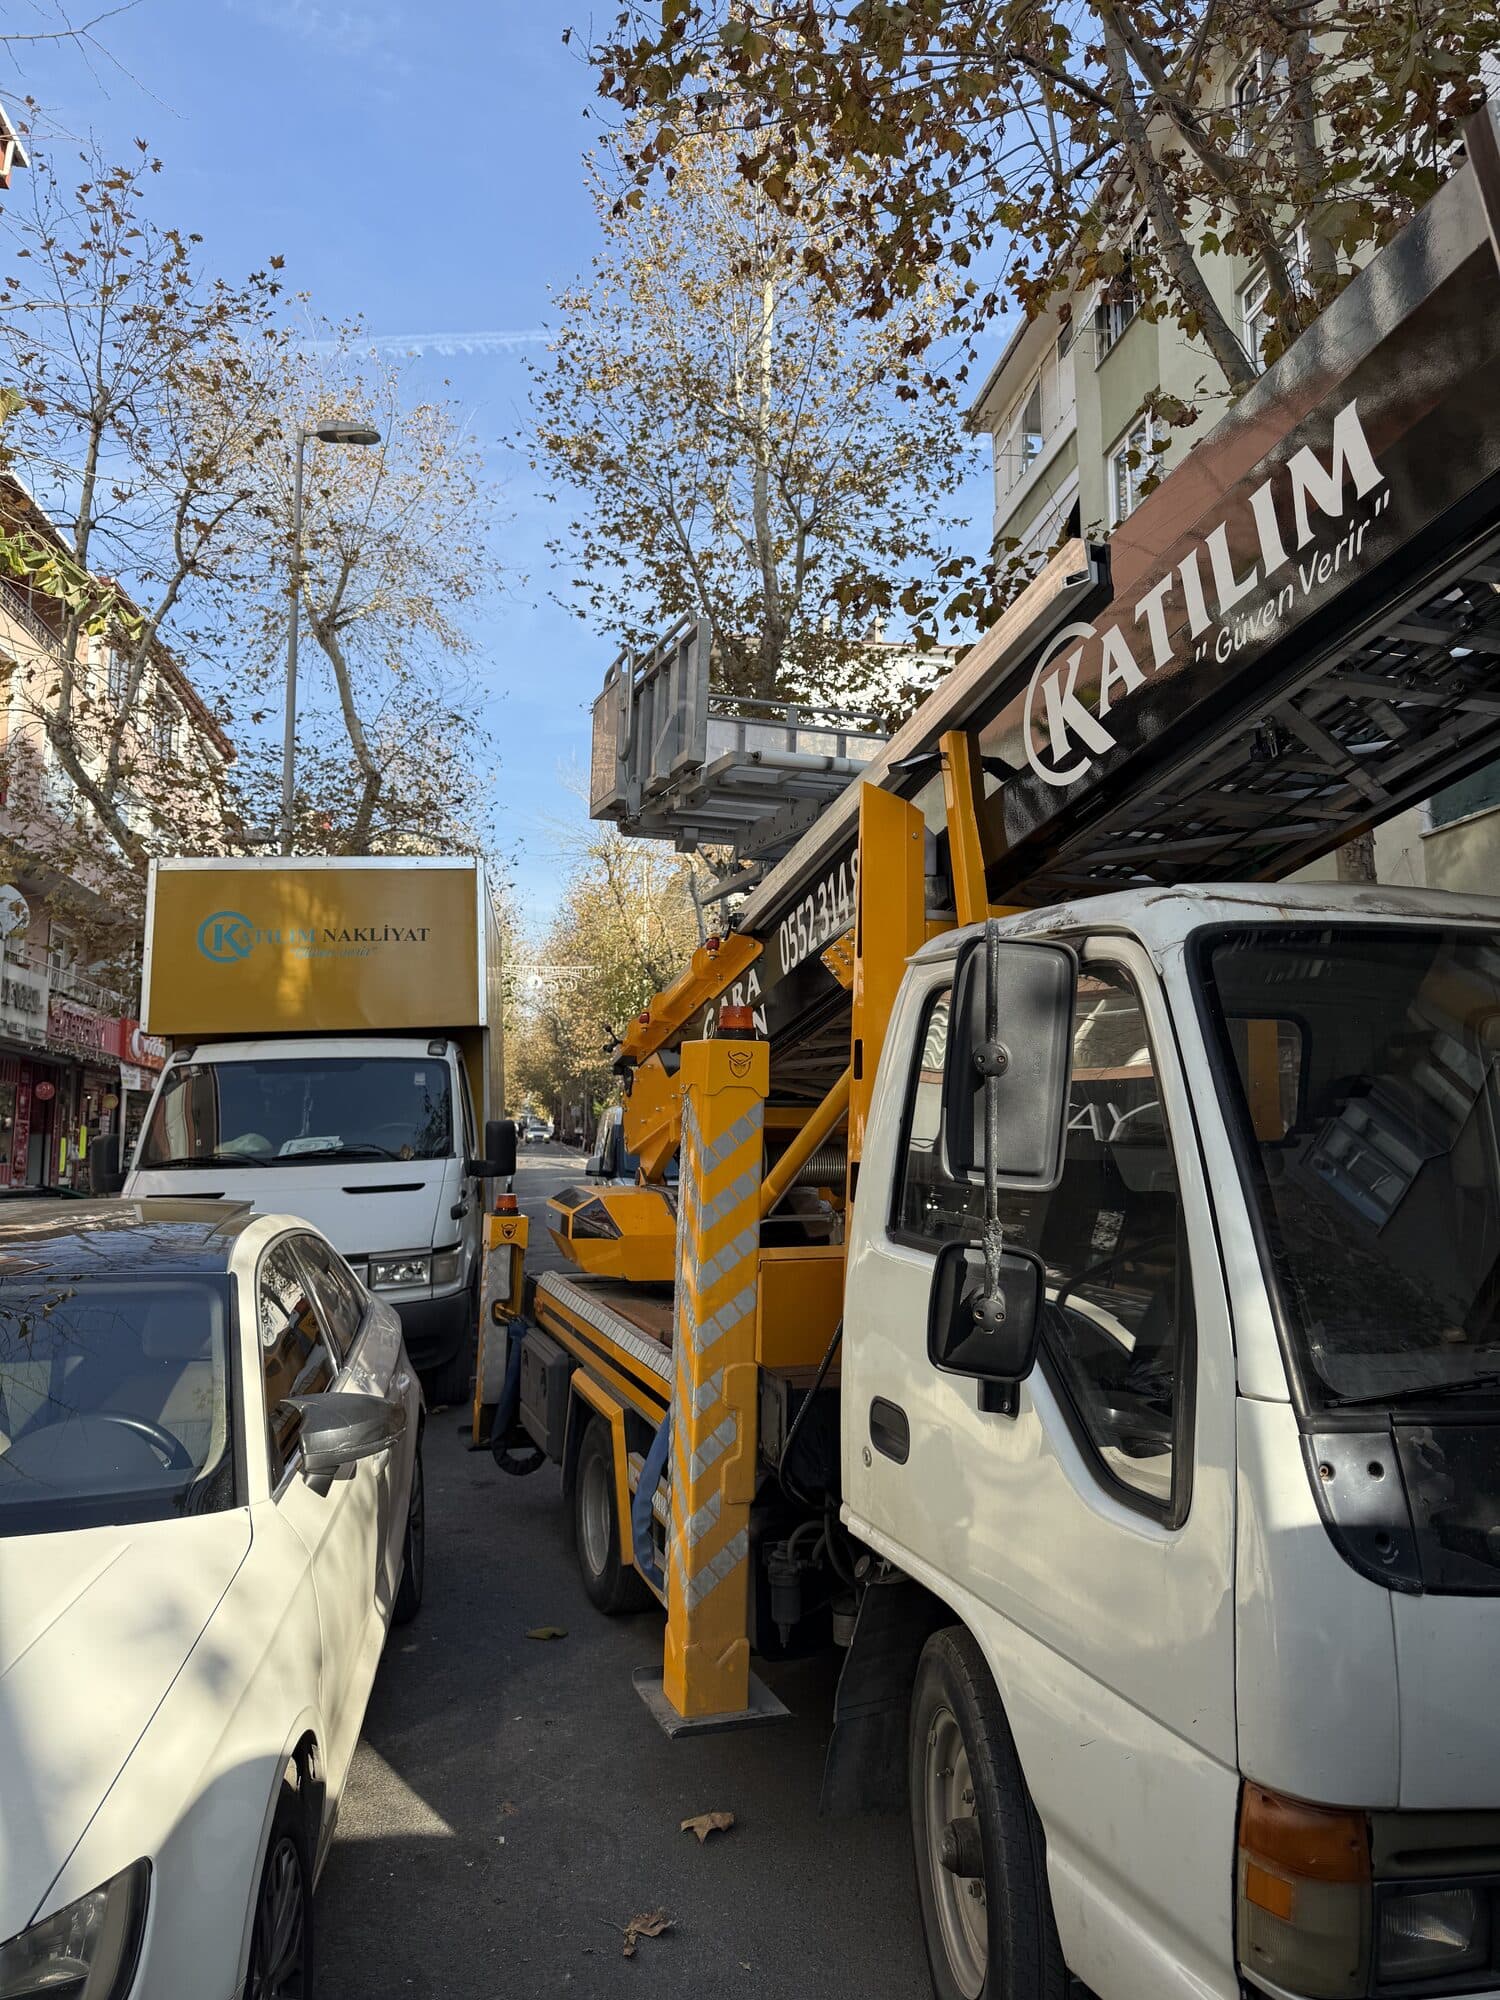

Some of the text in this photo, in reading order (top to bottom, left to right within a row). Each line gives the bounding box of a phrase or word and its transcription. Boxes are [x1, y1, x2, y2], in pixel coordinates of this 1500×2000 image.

[1024, 397, 1385, 787] KATILIM
[322, 924, 431, 943] NAKLİYAT
[779, 894, 817, 976] 0552
[817, 862, 849, 938] 314
